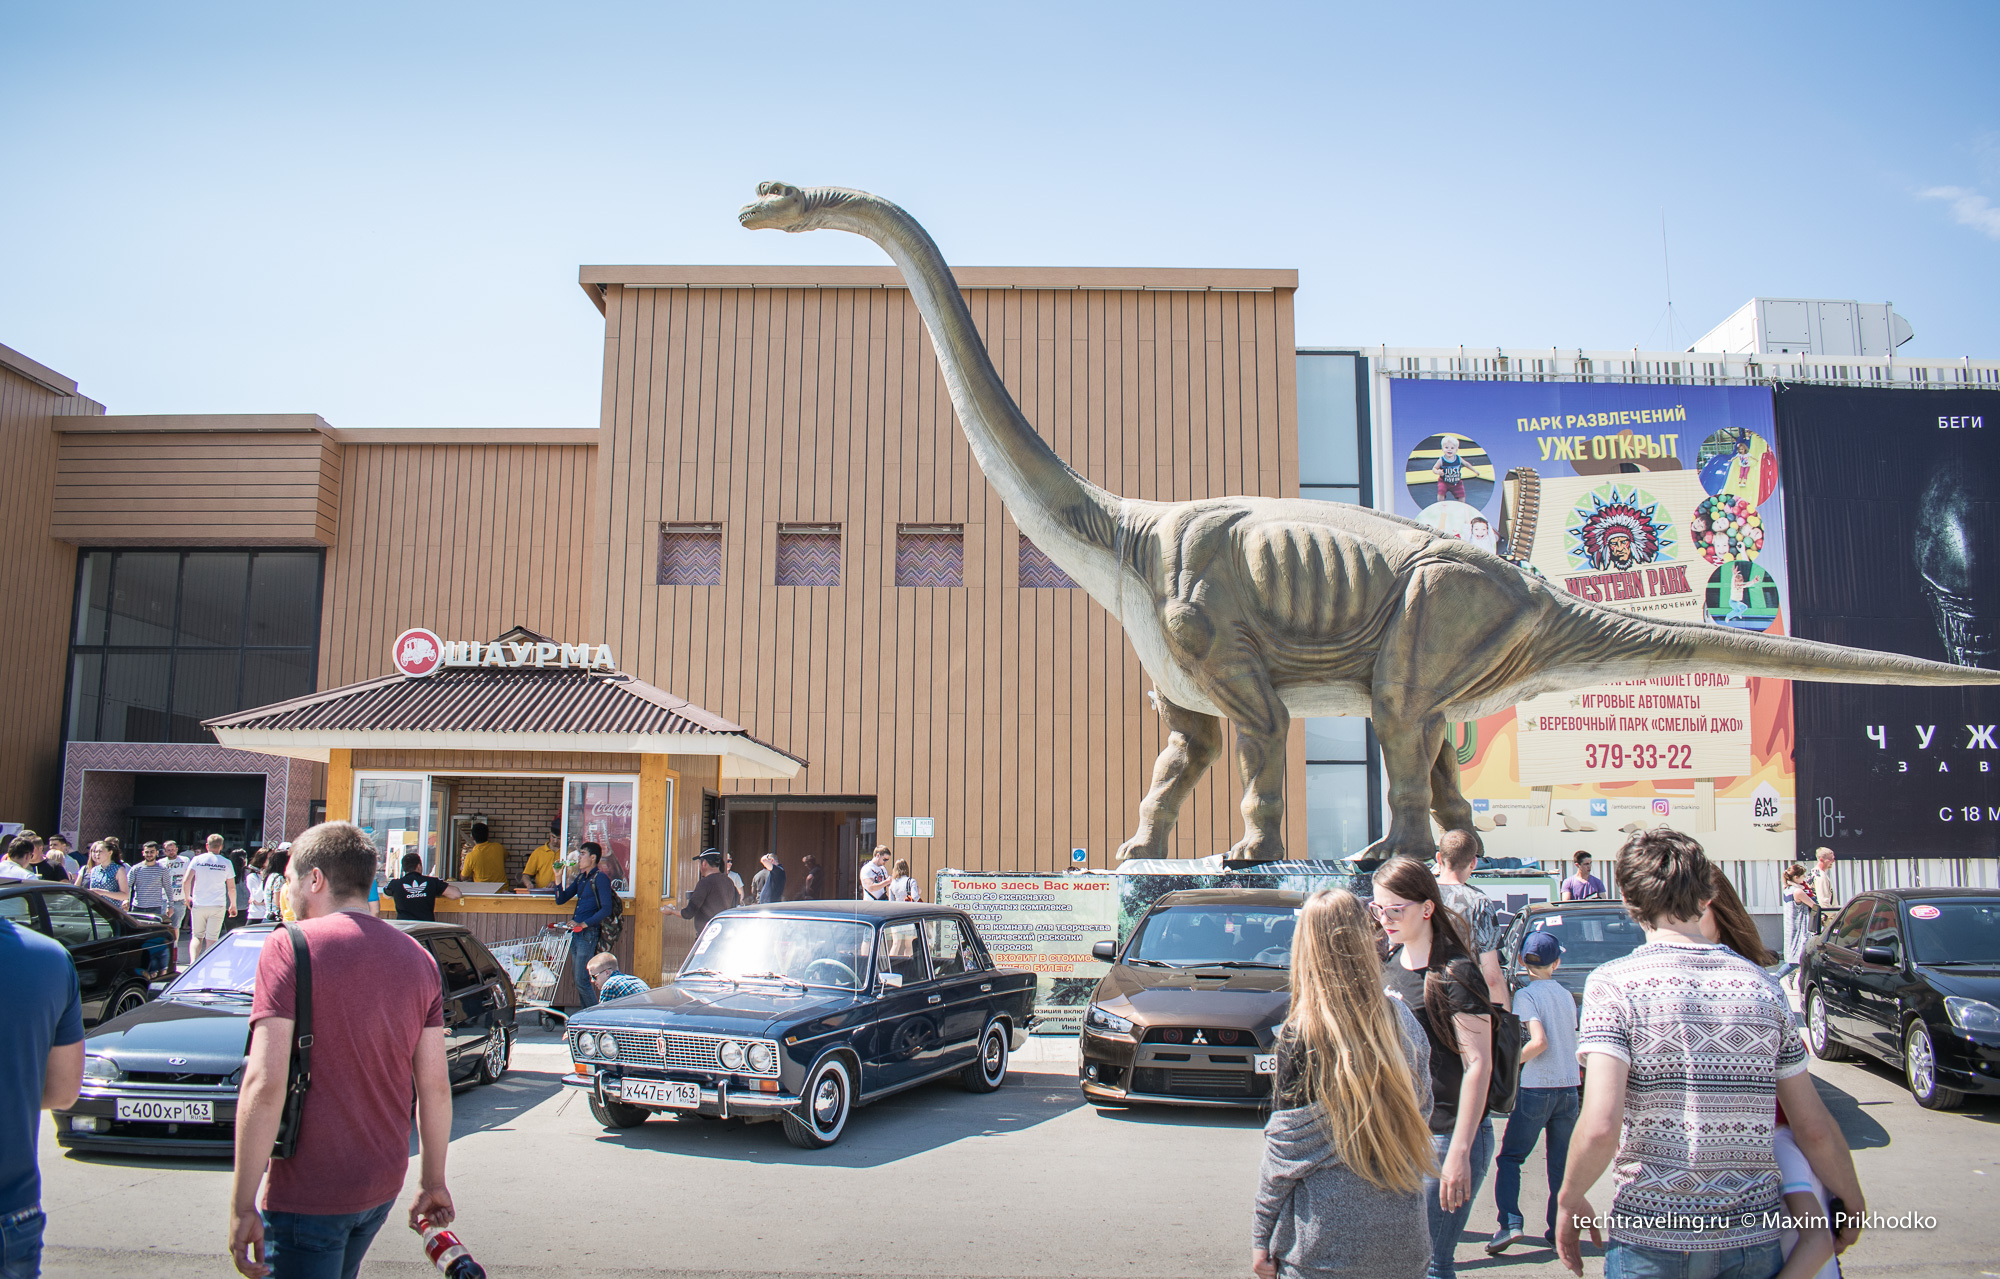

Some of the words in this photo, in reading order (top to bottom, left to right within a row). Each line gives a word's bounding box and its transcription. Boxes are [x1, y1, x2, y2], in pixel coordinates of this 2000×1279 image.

[1517, 416, 1563, 432] ПАРК
[1566, 404, 1687, 429] РАЗВЛЕЧЕНИЙ
[1938, 416, 1983, 429] БЕГИ
[1537, 436, 1588, 461] УЖЕ
[1592, 434, 1679, 460] ОТКРЫТ
[1565, 570, 1645, 602] WESTERN
[1646, 565, 1692, 596] PARK
[1631, 598, 1698, 612] ПРИКЛЮЧЕНИЙ
[445, 640, 616, 669] ШАУРМА
[1694, 672, 1730, 687] ОРЛА»
[1582, 694, 1635, 709] ИГРОВЫЕ
[1638, 695, 1700, 709] АВТОМАТЫ
[1540, 714, 1616, 731] ВЕРЕВОЧНЫЙ
[1619, 717, 1649, 731] ПАРК
[1651, 714, 1707, 732] «СМЕЛЫЙ
[1710, 717, 1744, 733] ДЖО»
[1585, 743, 1693, 769] 379-33-22
[1755, 798, 1773, 807] АМ
[1755, 807, 1778, 816] БАР
[1816, 796, 1845, 838] 18+
[1961, 806, 1980, 821] 18
[950, 880, 997, 890] Только
[1001, 882, 1039, 891] здесь
[1044, 881, 1069, 891] Вас
[1073, 882, 1110, 891] ждет:
[952, 892, 981, 901] более
[983, 893, 997, 901] 20
[953, 903, 970, 911] два
[972, 902, 1019, 912] батутных
[969, 914, 1002, 922] отеатр
[1056, 924, 1111, 932] творчества
[1037, 934, 1083, 942] раскопки
[995, 953, 1037, 962] ВХОДИТ
[1039, 954, 1047, 962] В
[1033, 964, 1074, 973] БИЛЕТА
[676, 1086, 695, 1099] 163
[186, 1103, 208, 1115] 163
